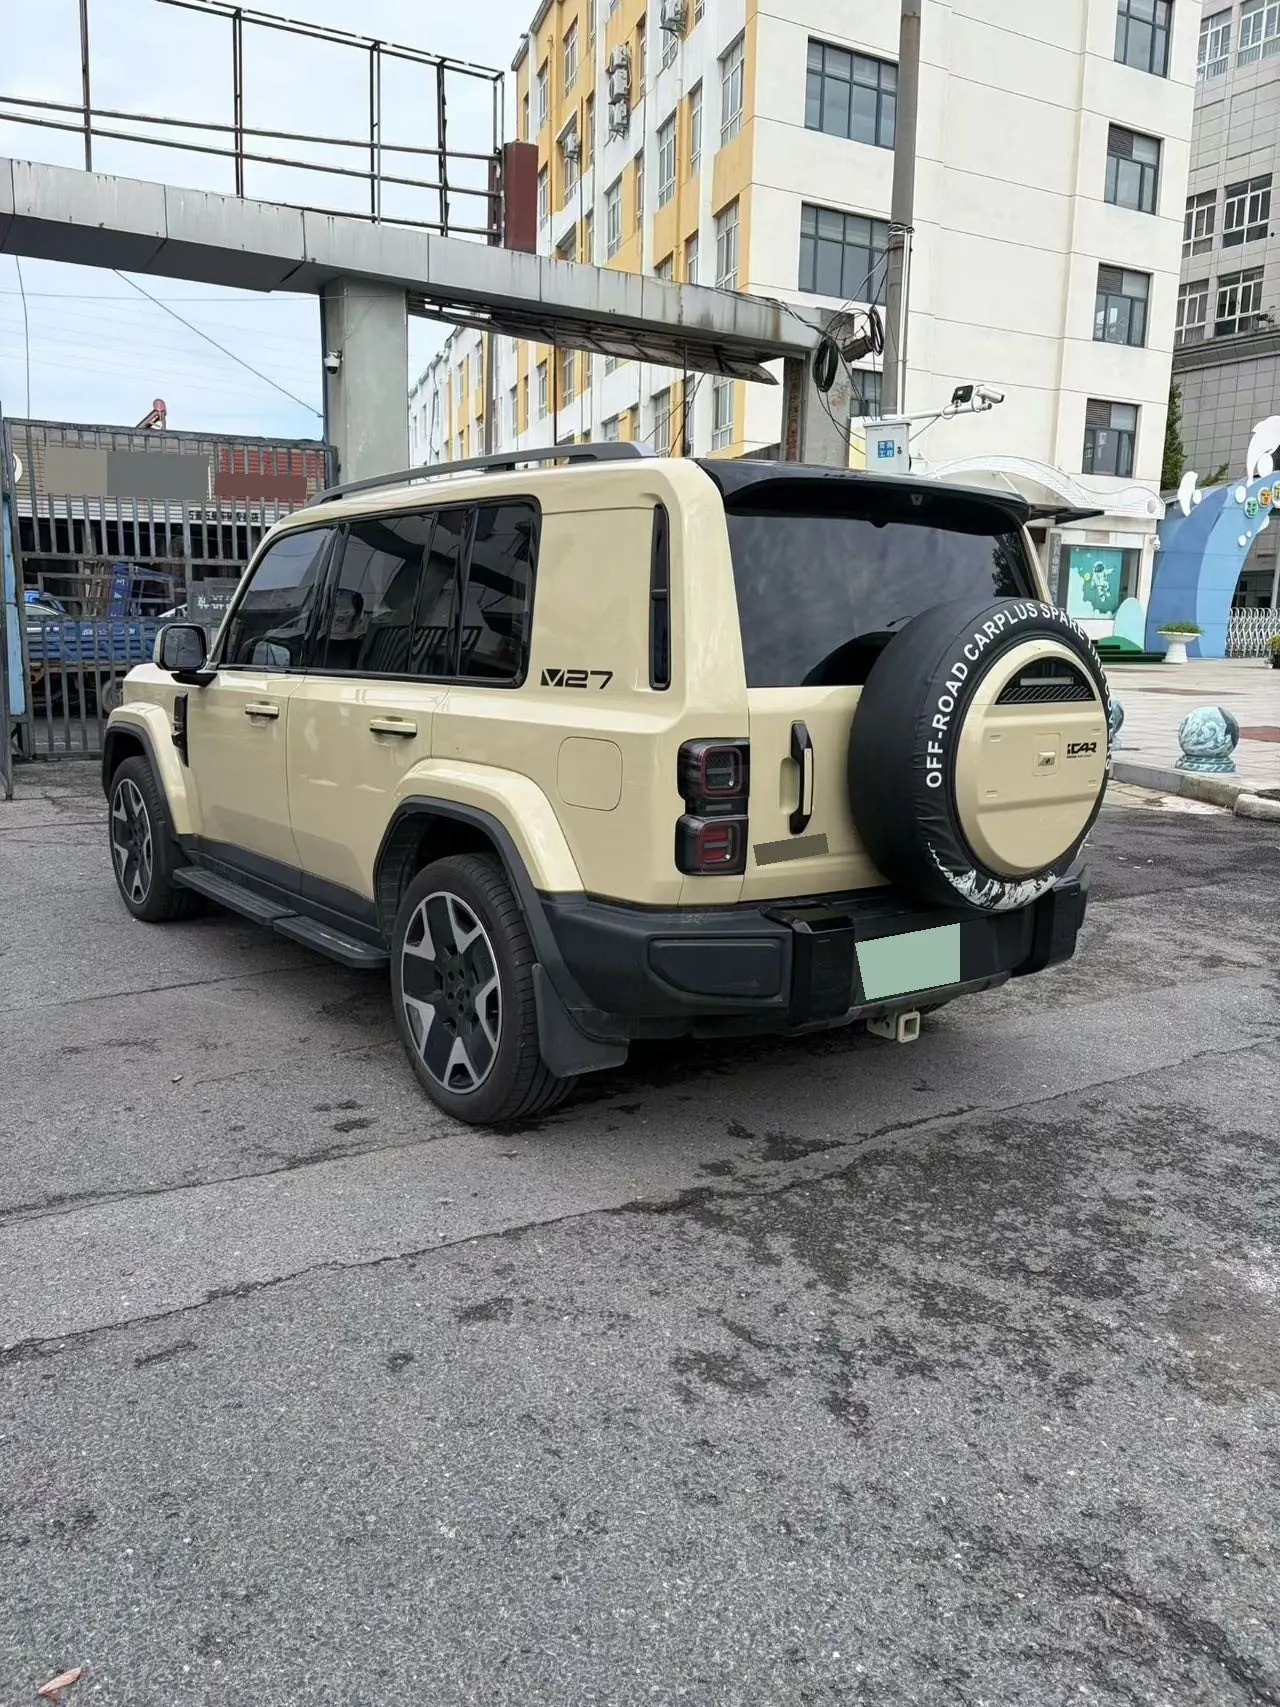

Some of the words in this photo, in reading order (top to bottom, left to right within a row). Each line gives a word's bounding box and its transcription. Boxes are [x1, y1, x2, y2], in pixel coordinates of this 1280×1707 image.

[540, 668, 614, 690] V27
[925, 661, 969, 788] OFF-ROAD
[964, 602, 1038, 661] CARPLUS
[1039, 603, 1086, 641] SPARE
